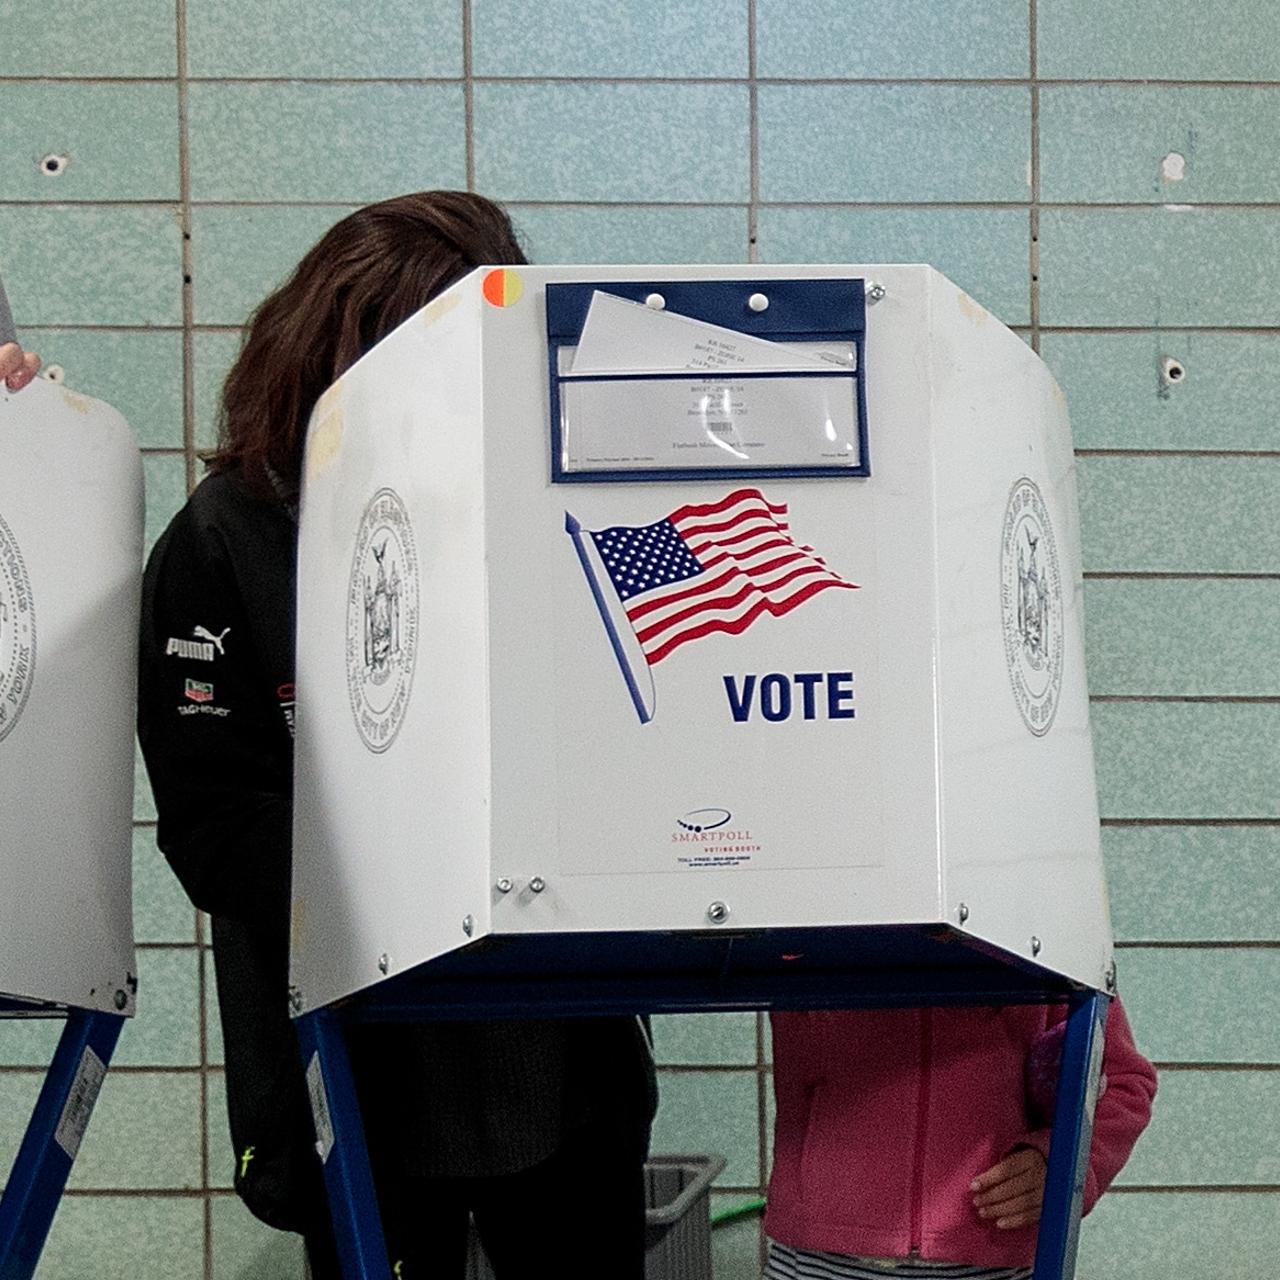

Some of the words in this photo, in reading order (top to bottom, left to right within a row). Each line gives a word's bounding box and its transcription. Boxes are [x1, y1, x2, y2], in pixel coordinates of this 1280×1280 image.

[166, 637, 214, 662] PUMA
[723, 672, 855, 722] VOTE
[671, 830, 753, 842] SMARTPOLL
